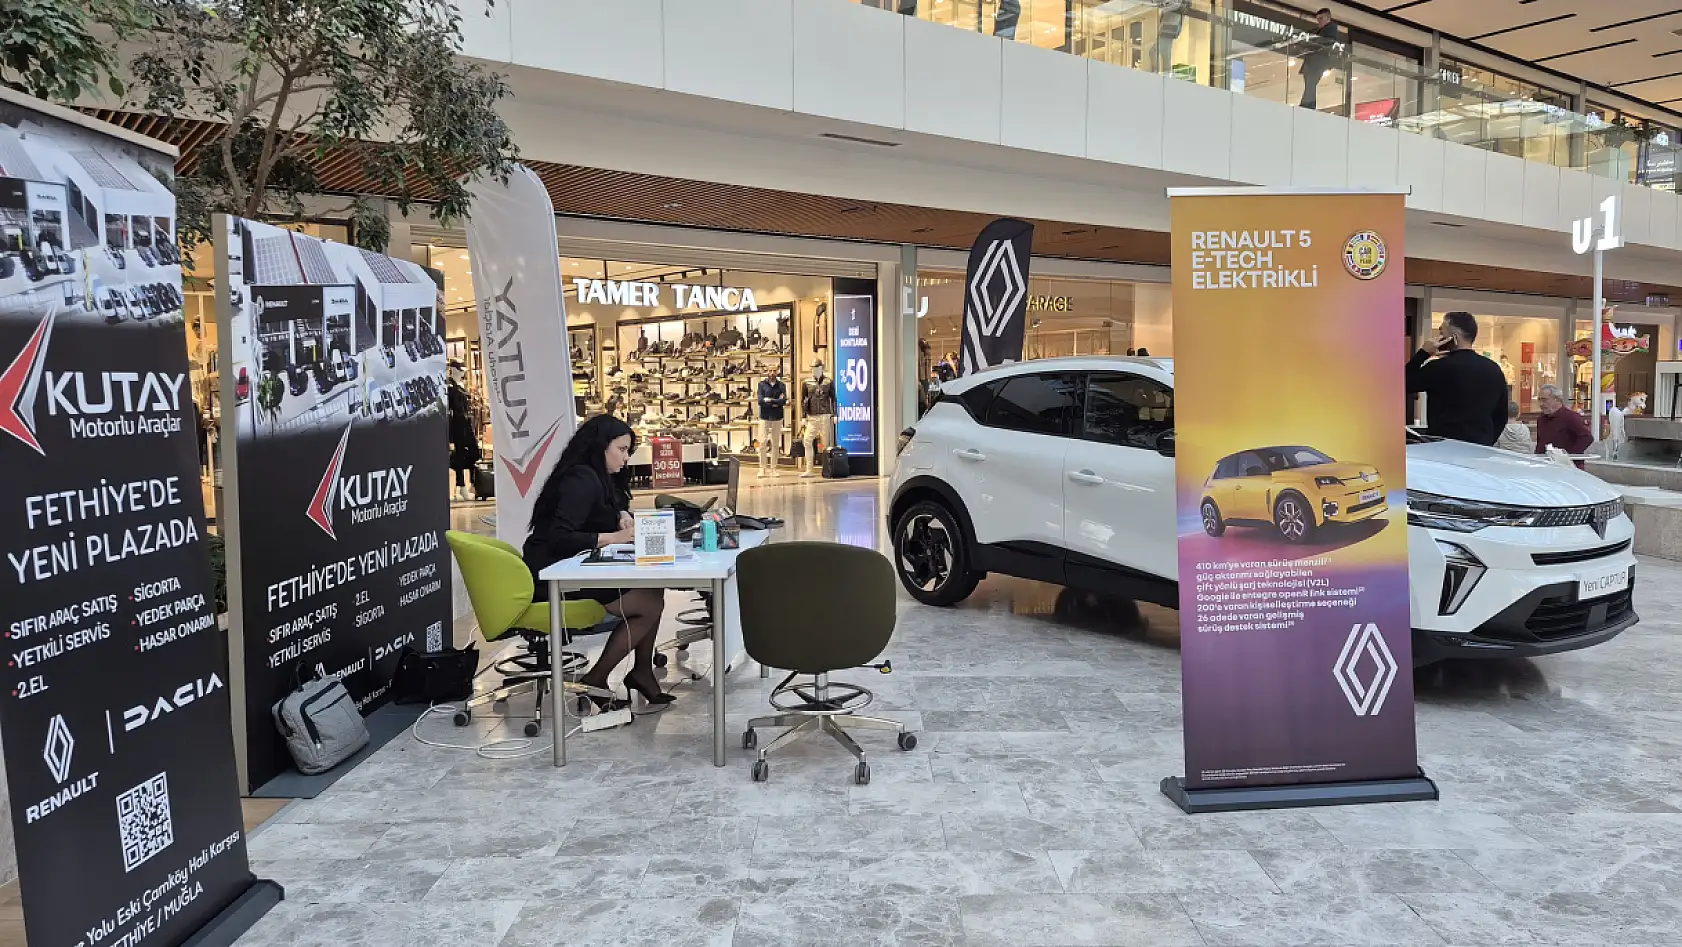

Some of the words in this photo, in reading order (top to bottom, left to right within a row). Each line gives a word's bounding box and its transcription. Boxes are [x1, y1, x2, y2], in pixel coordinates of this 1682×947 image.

[1191, 230, 1296, 249] RENAULT
[1299, 230, 1312, 248] 5
[1192, 251, 1273, 269] E-TECH
[1192, 265, 1318, 289] ELEKTRİKLİ
[573, 278, 659, 307] TAMER
[671, 284, 758, 312] TANCA
[1026, 294, 1074, 312] ARAGE
[45, 370, 186, 415] KUTAY
[70, 415, 135, 439] Motorlu
[137, 413, 182, 438] Araçlar
[25, 476, 182, 530] FETHİYE'DE
[340, 464, 414, 510] KUTAY
[351, 504, 382, 526] Motorlu
[383, 498, 408, 517] Araçlar
[8, 532, 78, 585] YENİ
[86, 516, 199, 566] PLAZADA
[1196, 562, 1211, 570] 410
[267, 557, 356, 613] FETHİYE'DE
[358, 541, 388, 577] YENİ
[391, 530, 439, 565] PLAZADA
[133, 576, 181, 602] SİGORTA
[1196, 593, 1229, 602] Google
[10, 615, 48, 640] SIFIR
[49, 604, 80, 629] ARAÇ
[82, 594, 118, 618] SATIŞ
[136, 604, 173, 627] YEDEK
[174, 593, 206, 615] PARÇA
[268, 622, 291, 644] SIFIR
[292, 613, 314, 632] ARAÇ
[315, 602, 338, 623] SATIŞ
[355, 604, 385, 628] SİGORTA
[12, 634, 64, 669] YETKİLİ
[65, 621, 110, 651] SERVİS
[139, 627, 177, 652] HASAR
[177, 613, 215, 638] ONARIM
[268, 639, 301, 669] YETKİLİ
[301, 627, 331, 653] SERVİS
[375, 632, 415, 660] DACIA
[333, 658, 365, 680] ENAULT
[17, 675, 49, 699] 2.EL
[123, 672, 224, 732] DACIA
[25, 771, 99, 824] RENAULT
[86, 918, 116, 947] Yolu
[117, 898, 142, 926] Eski
[143, 866, 189, 912] Çamköy
[188, 849, 208, 874] Hali
[209, 830, 240, 859] Karşısı
[109, 915, 156, 947] ETHİYE
[164, 881, 204, 921] MUĞLA
